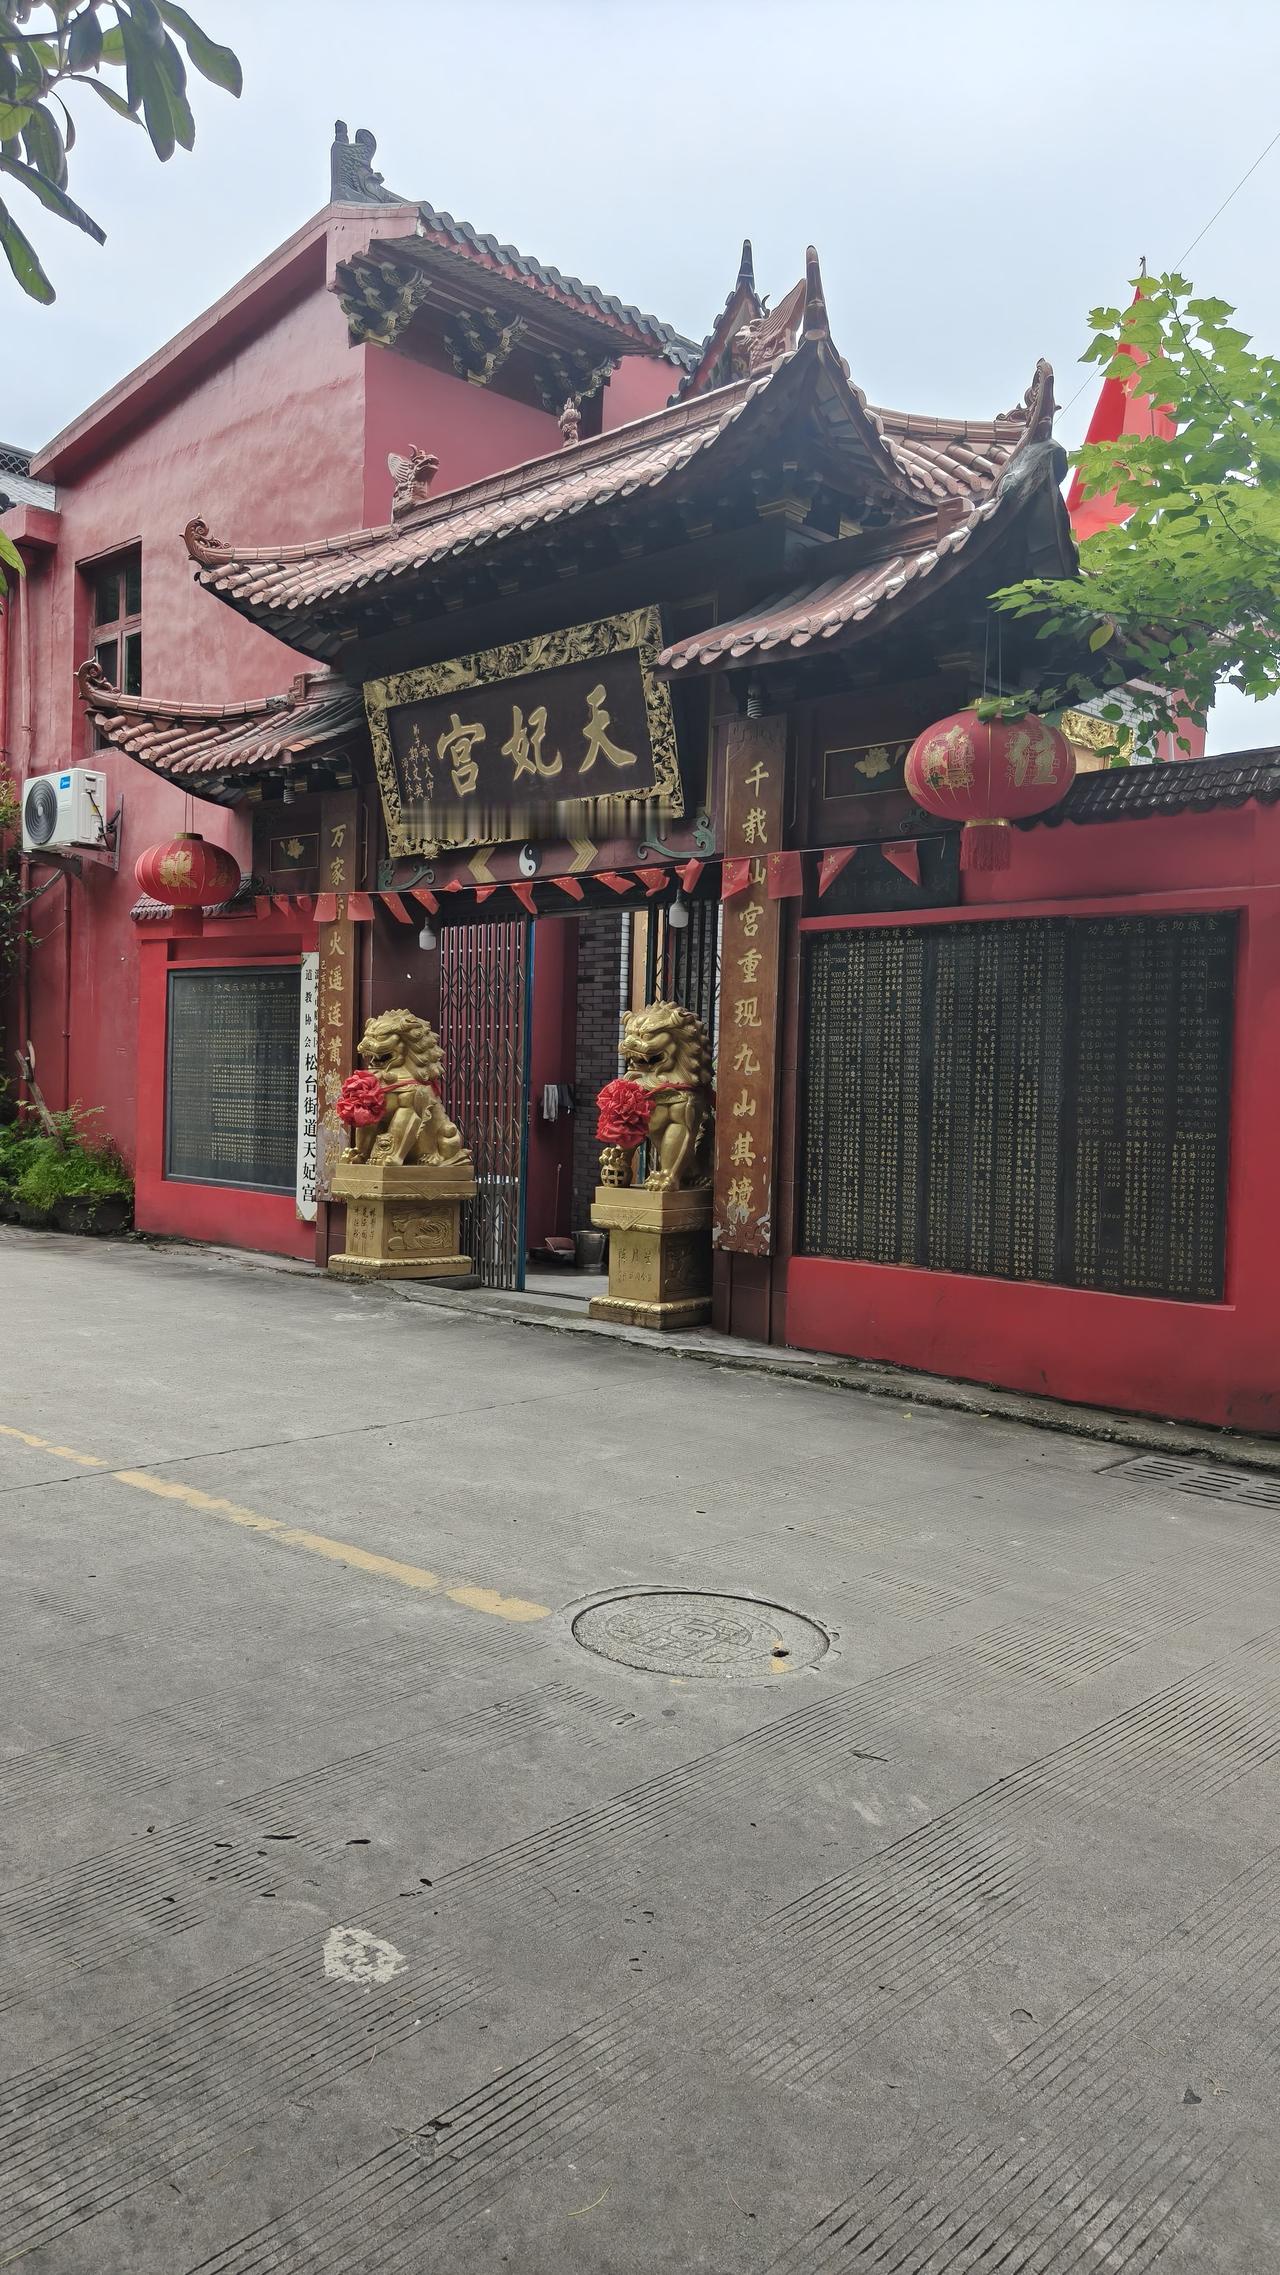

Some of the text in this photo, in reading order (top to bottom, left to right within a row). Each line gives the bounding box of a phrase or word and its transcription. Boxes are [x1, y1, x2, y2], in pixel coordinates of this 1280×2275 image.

[436, 684, 637, 797] 天妃宫
[302, 1053, 317, 1202] 松台街道天妃宫
